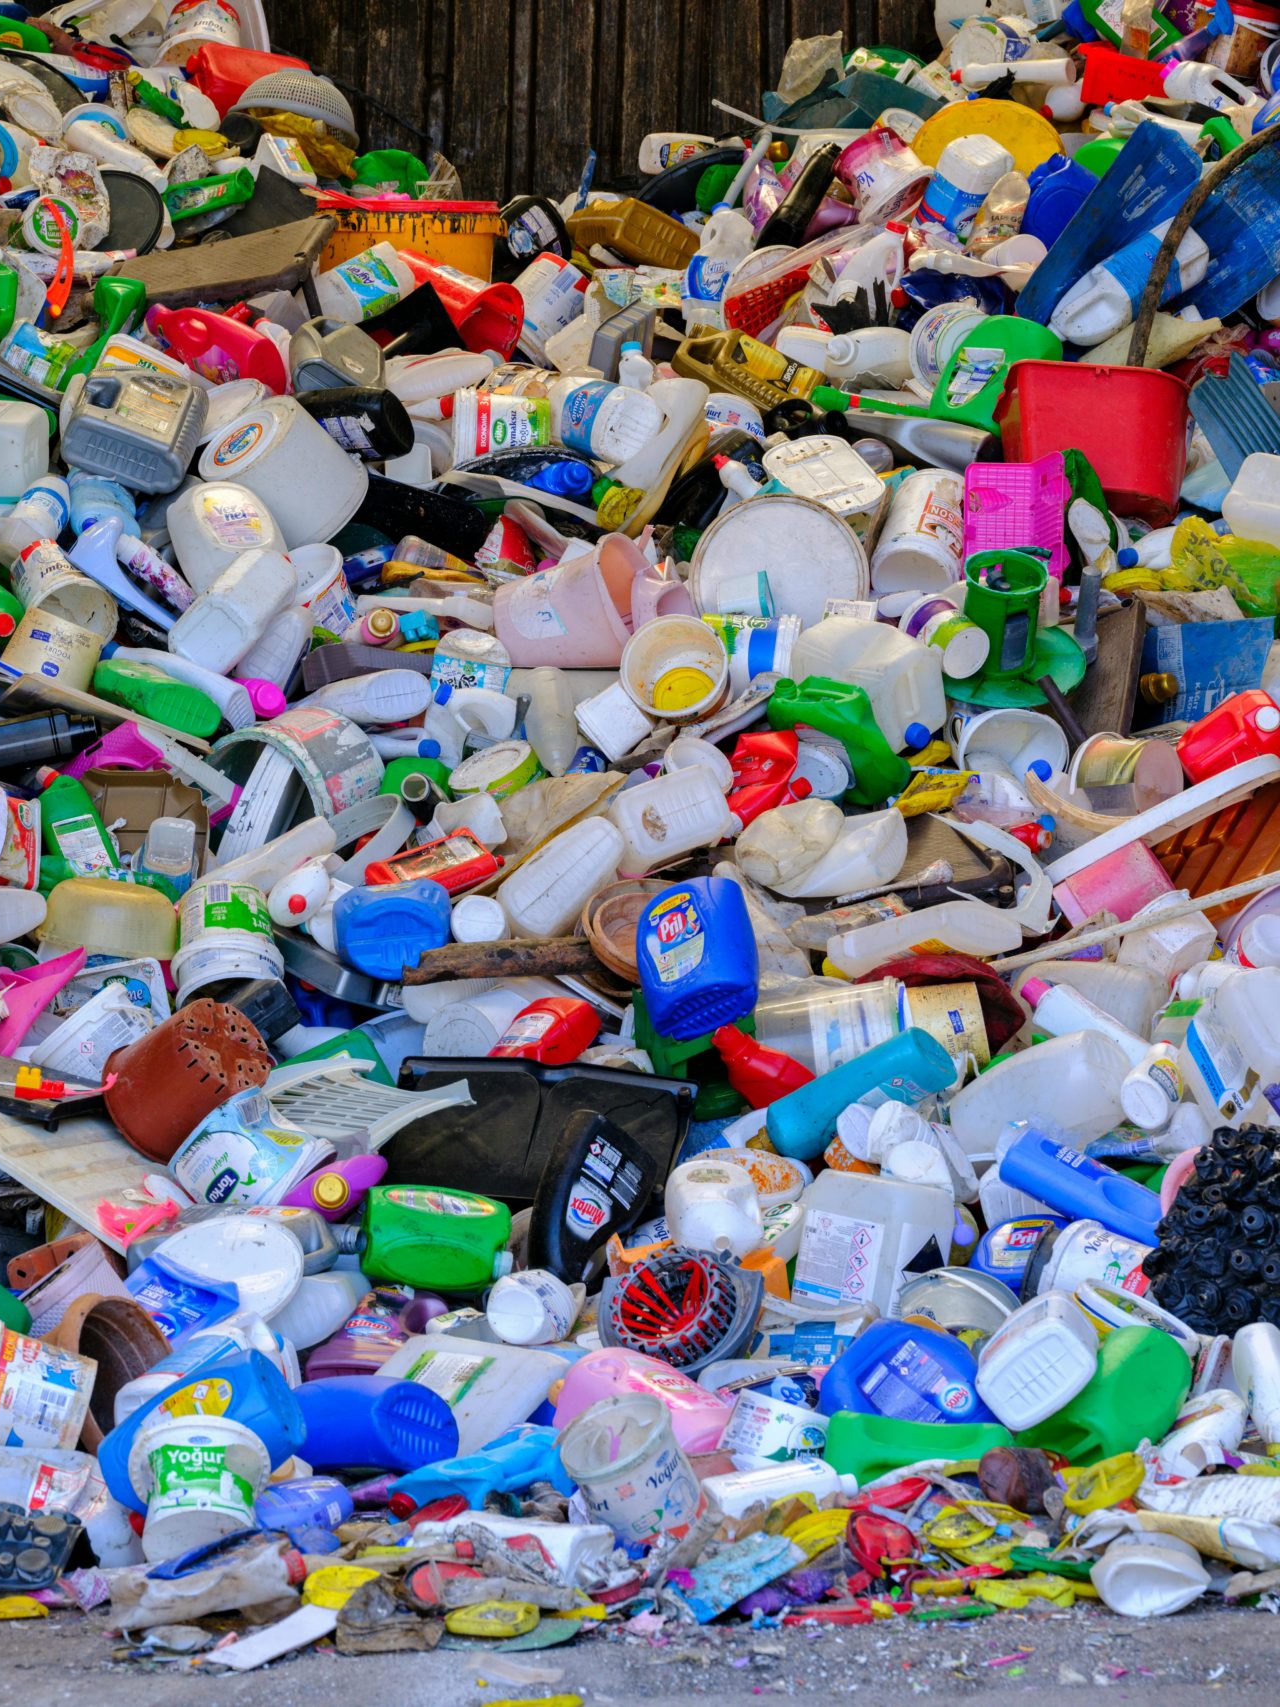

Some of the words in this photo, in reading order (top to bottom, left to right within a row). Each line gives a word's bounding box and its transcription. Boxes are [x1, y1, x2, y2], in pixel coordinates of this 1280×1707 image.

[660, 914, 683, 940] Pril
[208, 1171, 238, 1203] Torku
[571, 1196, 605, 1226] Mintax
[1009, 1231, 1039, 1245] Pril
[347, 1317, 391, 1332] Bingo
[167, 1447, 224, 1466] Yoğur
